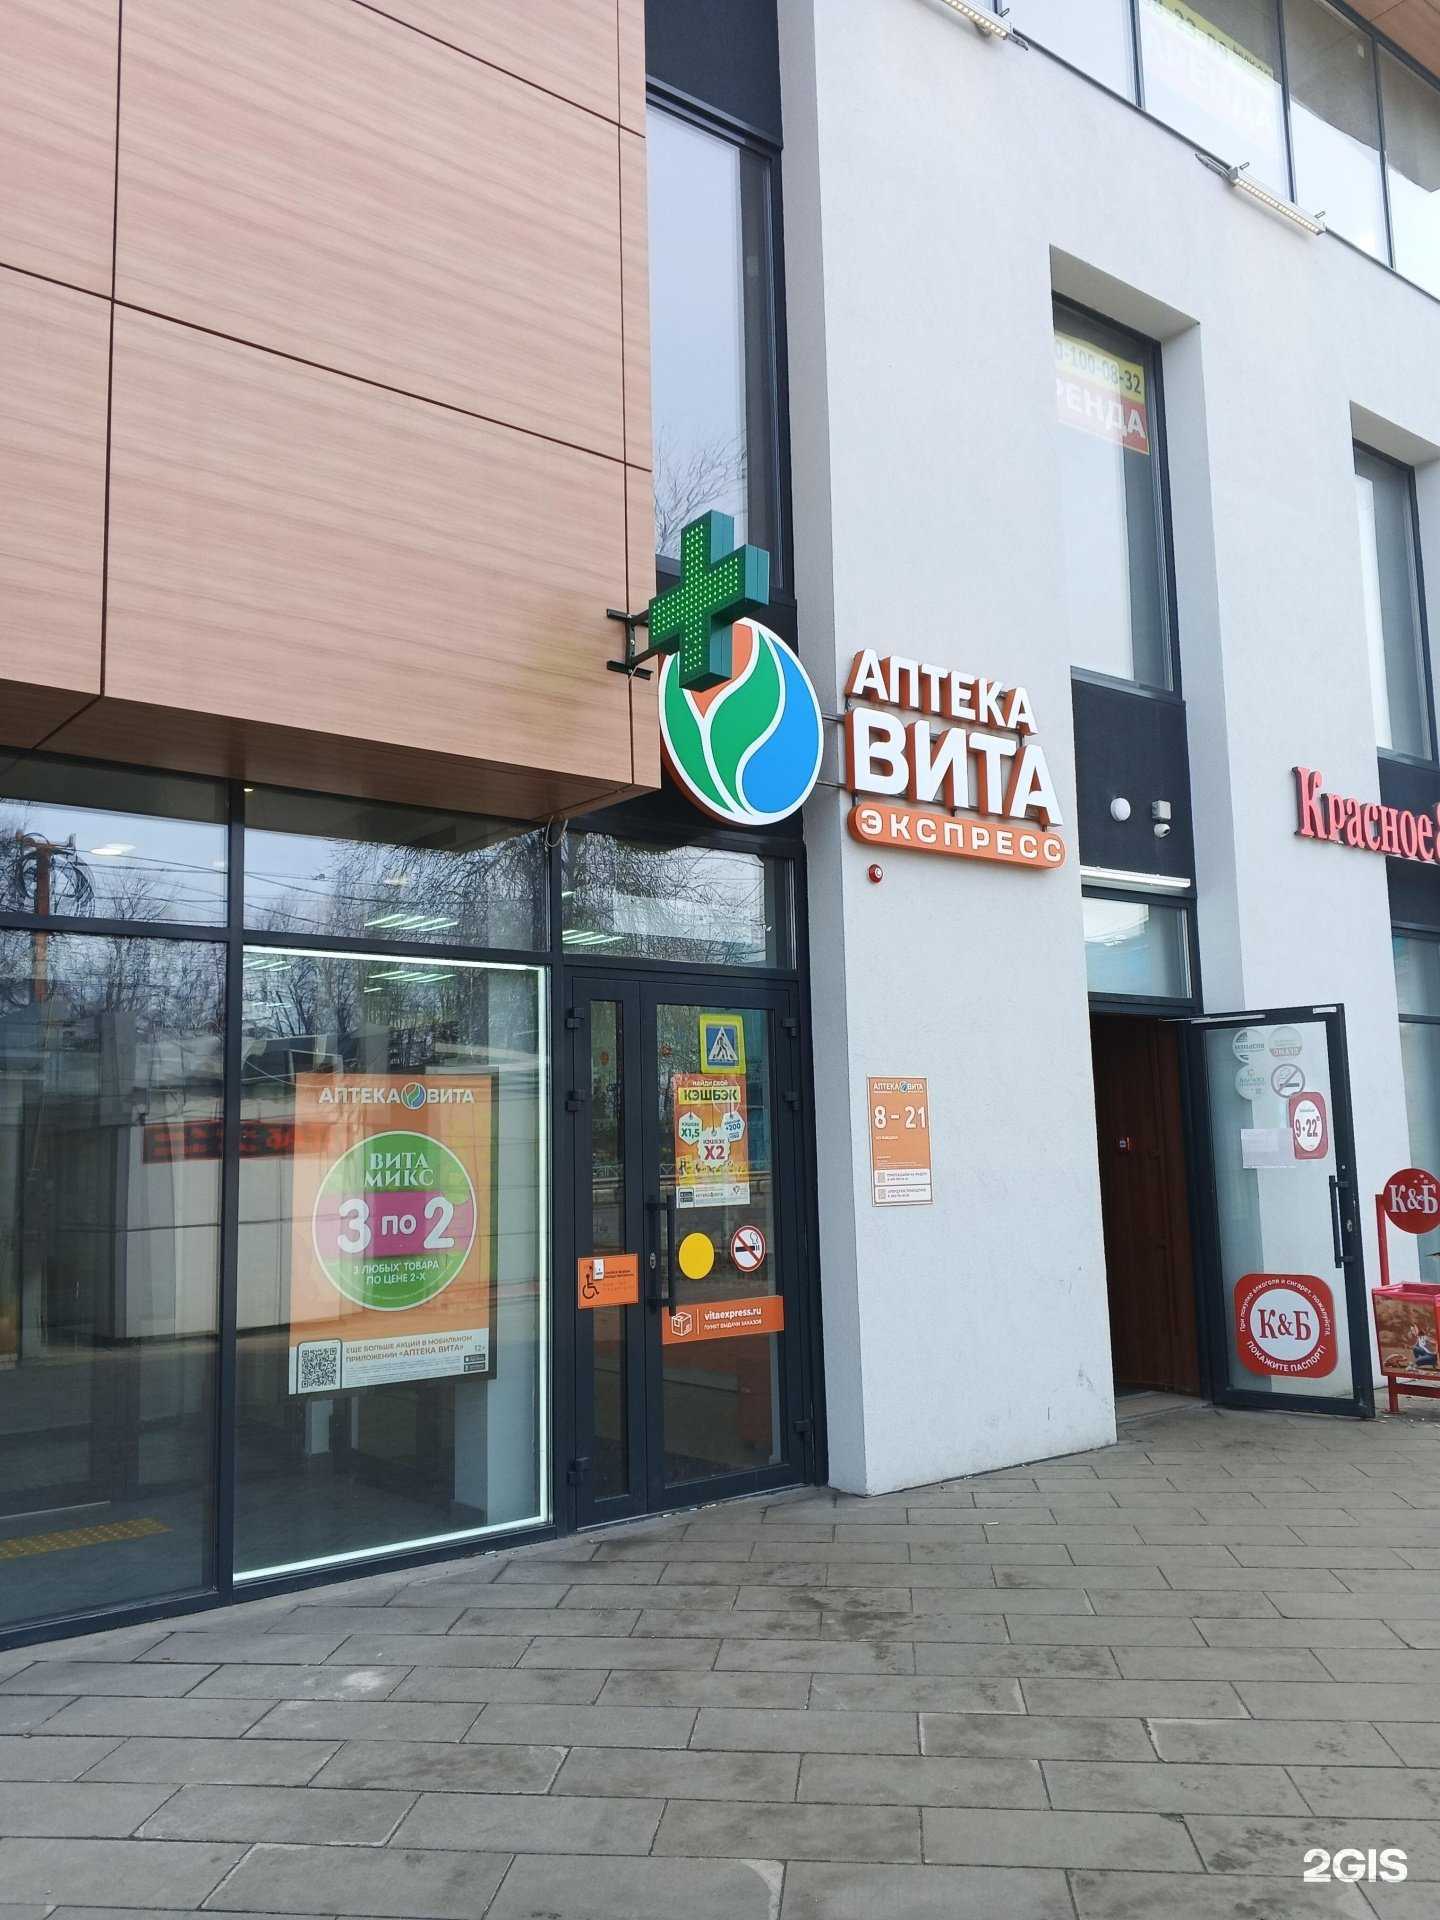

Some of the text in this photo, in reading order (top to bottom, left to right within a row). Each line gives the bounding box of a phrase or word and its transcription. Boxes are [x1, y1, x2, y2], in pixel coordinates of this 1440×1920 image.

[848, 648, 1039, 736] АПТЕКА
[846, 706, 1065, 828] ВИТА
[1292, 766, 1440, 861] Красное
[860, 808, 1063, 863] ЭКСПРЕСС
[318, 1086, 474, 1105] АПТЕКА ВИТА
[684, 1089, 738, 1101] КЭШБЭК
[873, 1082, 923, 1091] АПТЕКА ВИТА
[874, 1105, 887, 1129] 8
[905, 1106, 926, 1129] 21
[369, 1151, 430, 1170] ВИТА
[364, 1169, 434, 1187] МИКС
[1389, 1184, 1439, 1215] К&Б
[337, 1198, 371, 1253] 3
[424, 1196, 455, 1250] 2
[404, 1260, 439, 1271] ТОВАРА
[366, 1276, 381, 1286] ПО
[384, 1274, 408, 1284] ЦЕНЕ
[704, 1308, 762, 1320] vitaexpress.ru
[1257, 1308, 1312, 1341] К&Б
[1247, 1340, 1326, 1372] ПОКАЖИТЕ ПАСПОРТ!
